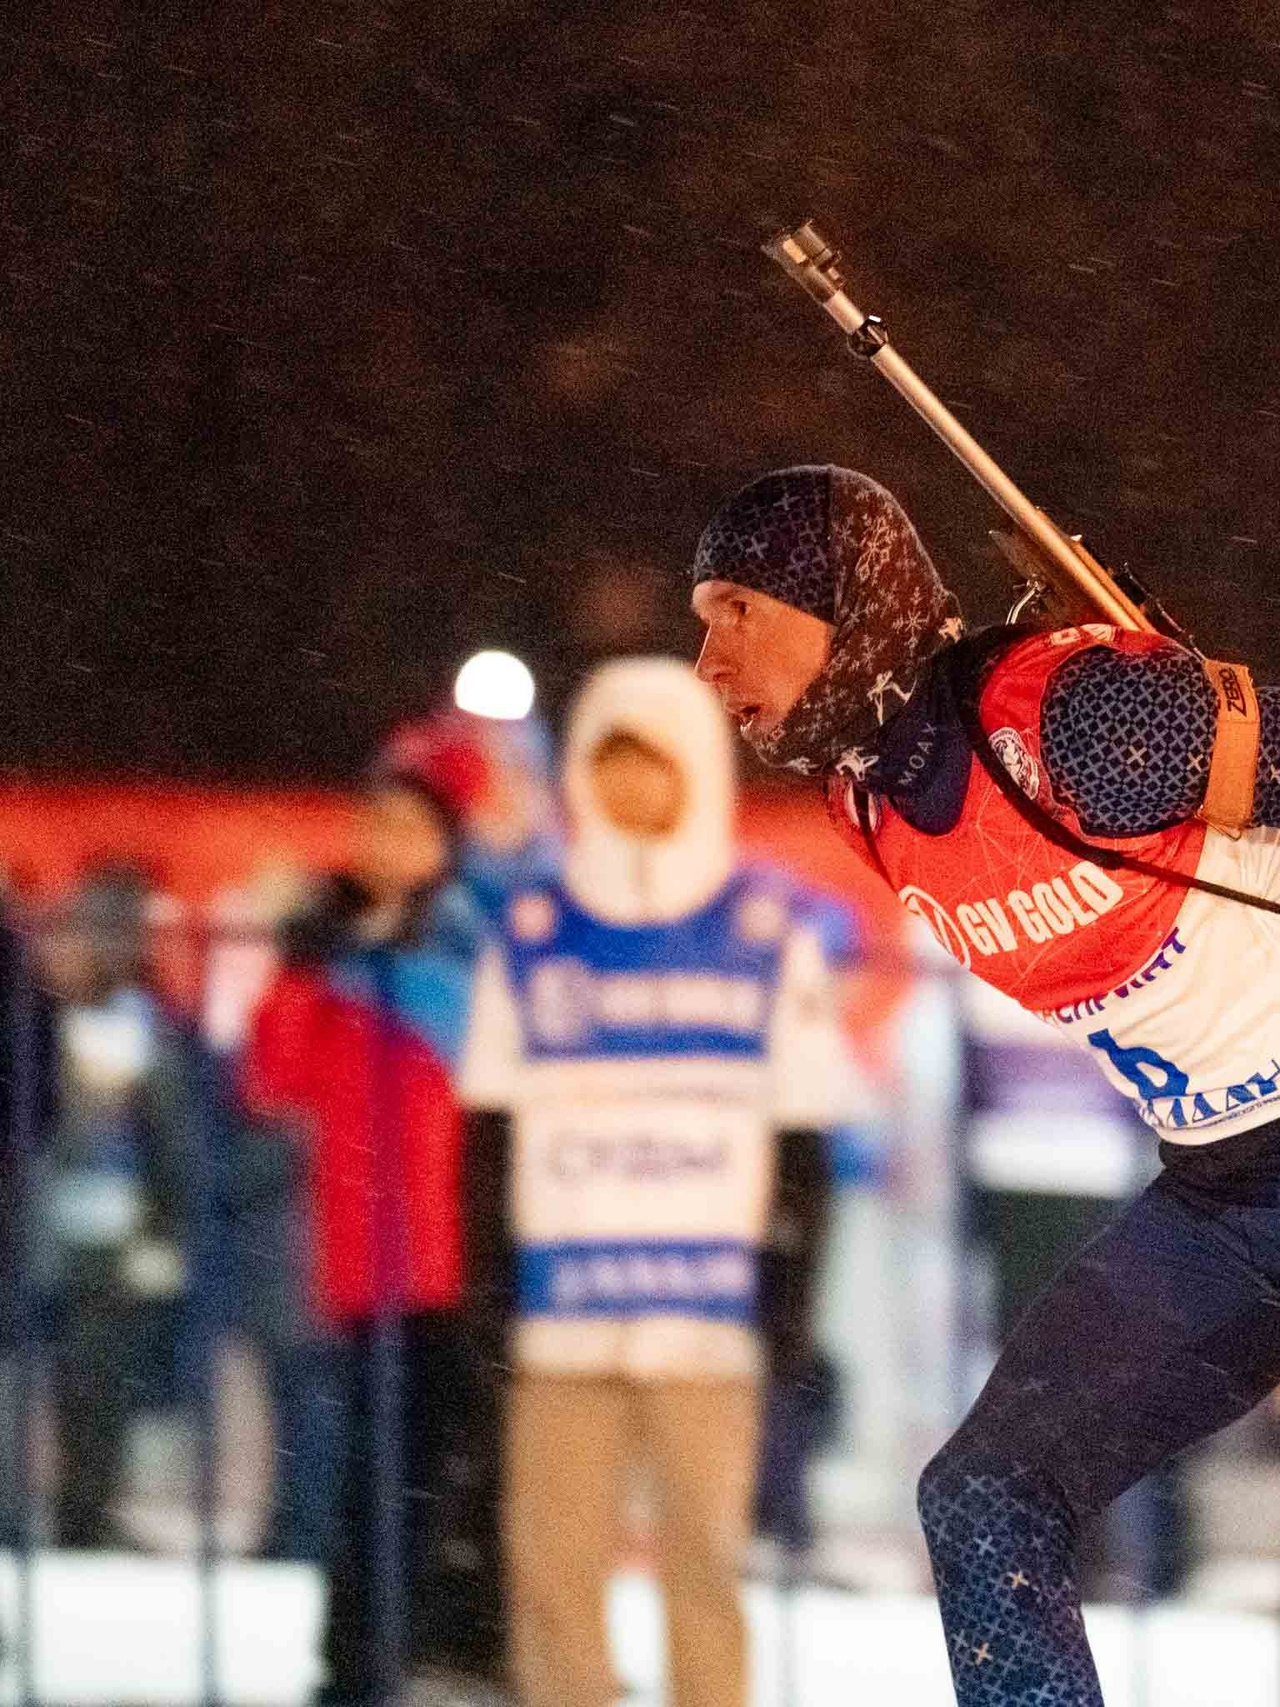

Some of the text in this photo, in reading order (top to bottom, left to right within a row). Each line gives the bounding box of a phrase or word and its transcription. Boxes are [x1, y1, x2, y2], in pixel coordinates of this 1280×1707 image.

[1219, 666, 1247, 717] ZERO
[897, 722, 938, 786] MOAX
[956, 860, 1124, 956] GV GOLD
